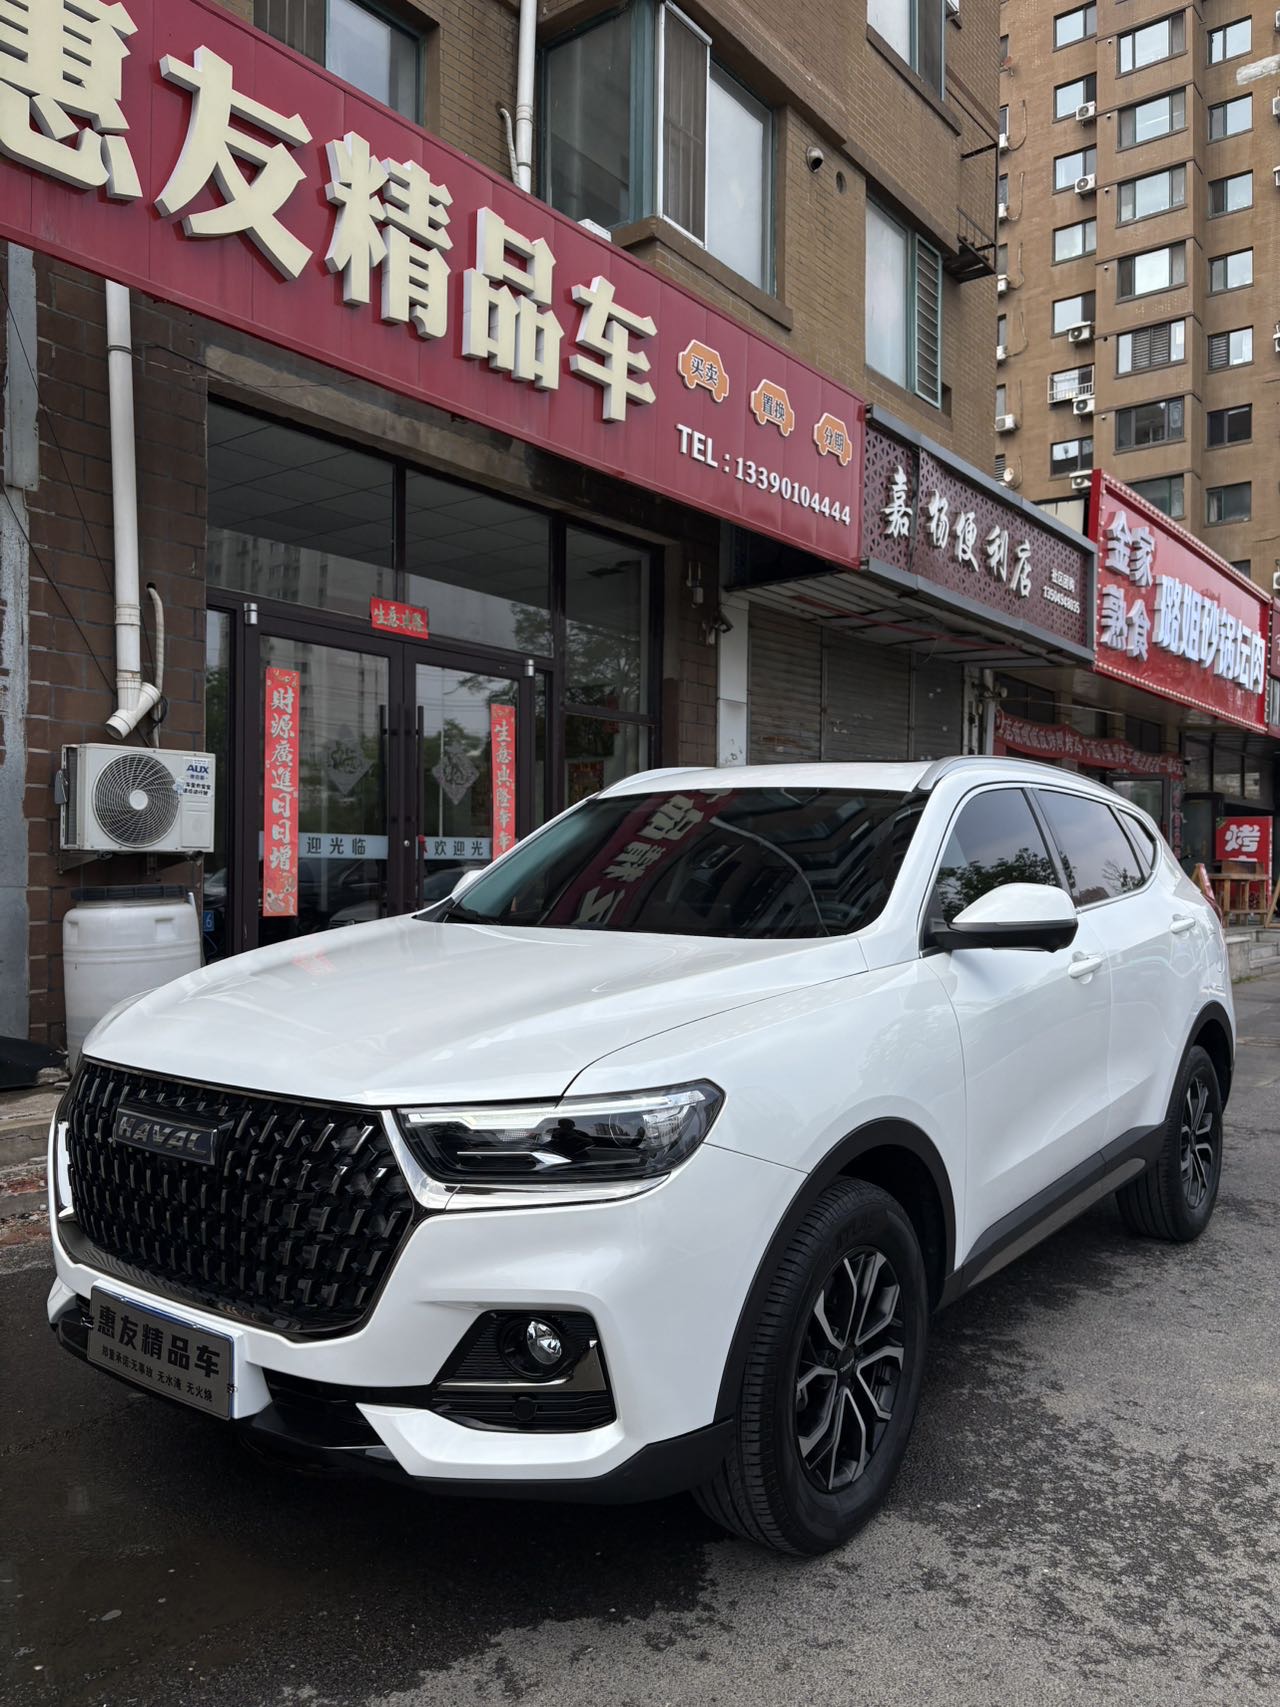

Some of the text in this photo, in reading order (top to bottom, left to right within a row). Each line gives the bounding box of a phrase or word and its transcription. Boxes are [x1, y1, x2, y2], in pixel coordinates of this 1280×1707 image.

[0, 0, 657, 421] 惠友精品车
[691, 354, 845, 452] 买卖 置换 分期
[735, 457, 851, 526] 13390104444
[1104, 510, 1155, 587] 金家
[1100, 584, 1151, 662] 熟食
[186, 764, 209, 774] AUX
[118, 1116, 208, 1156] HAVAL
[97, 1304, 221, 1379] 惠友精品车
